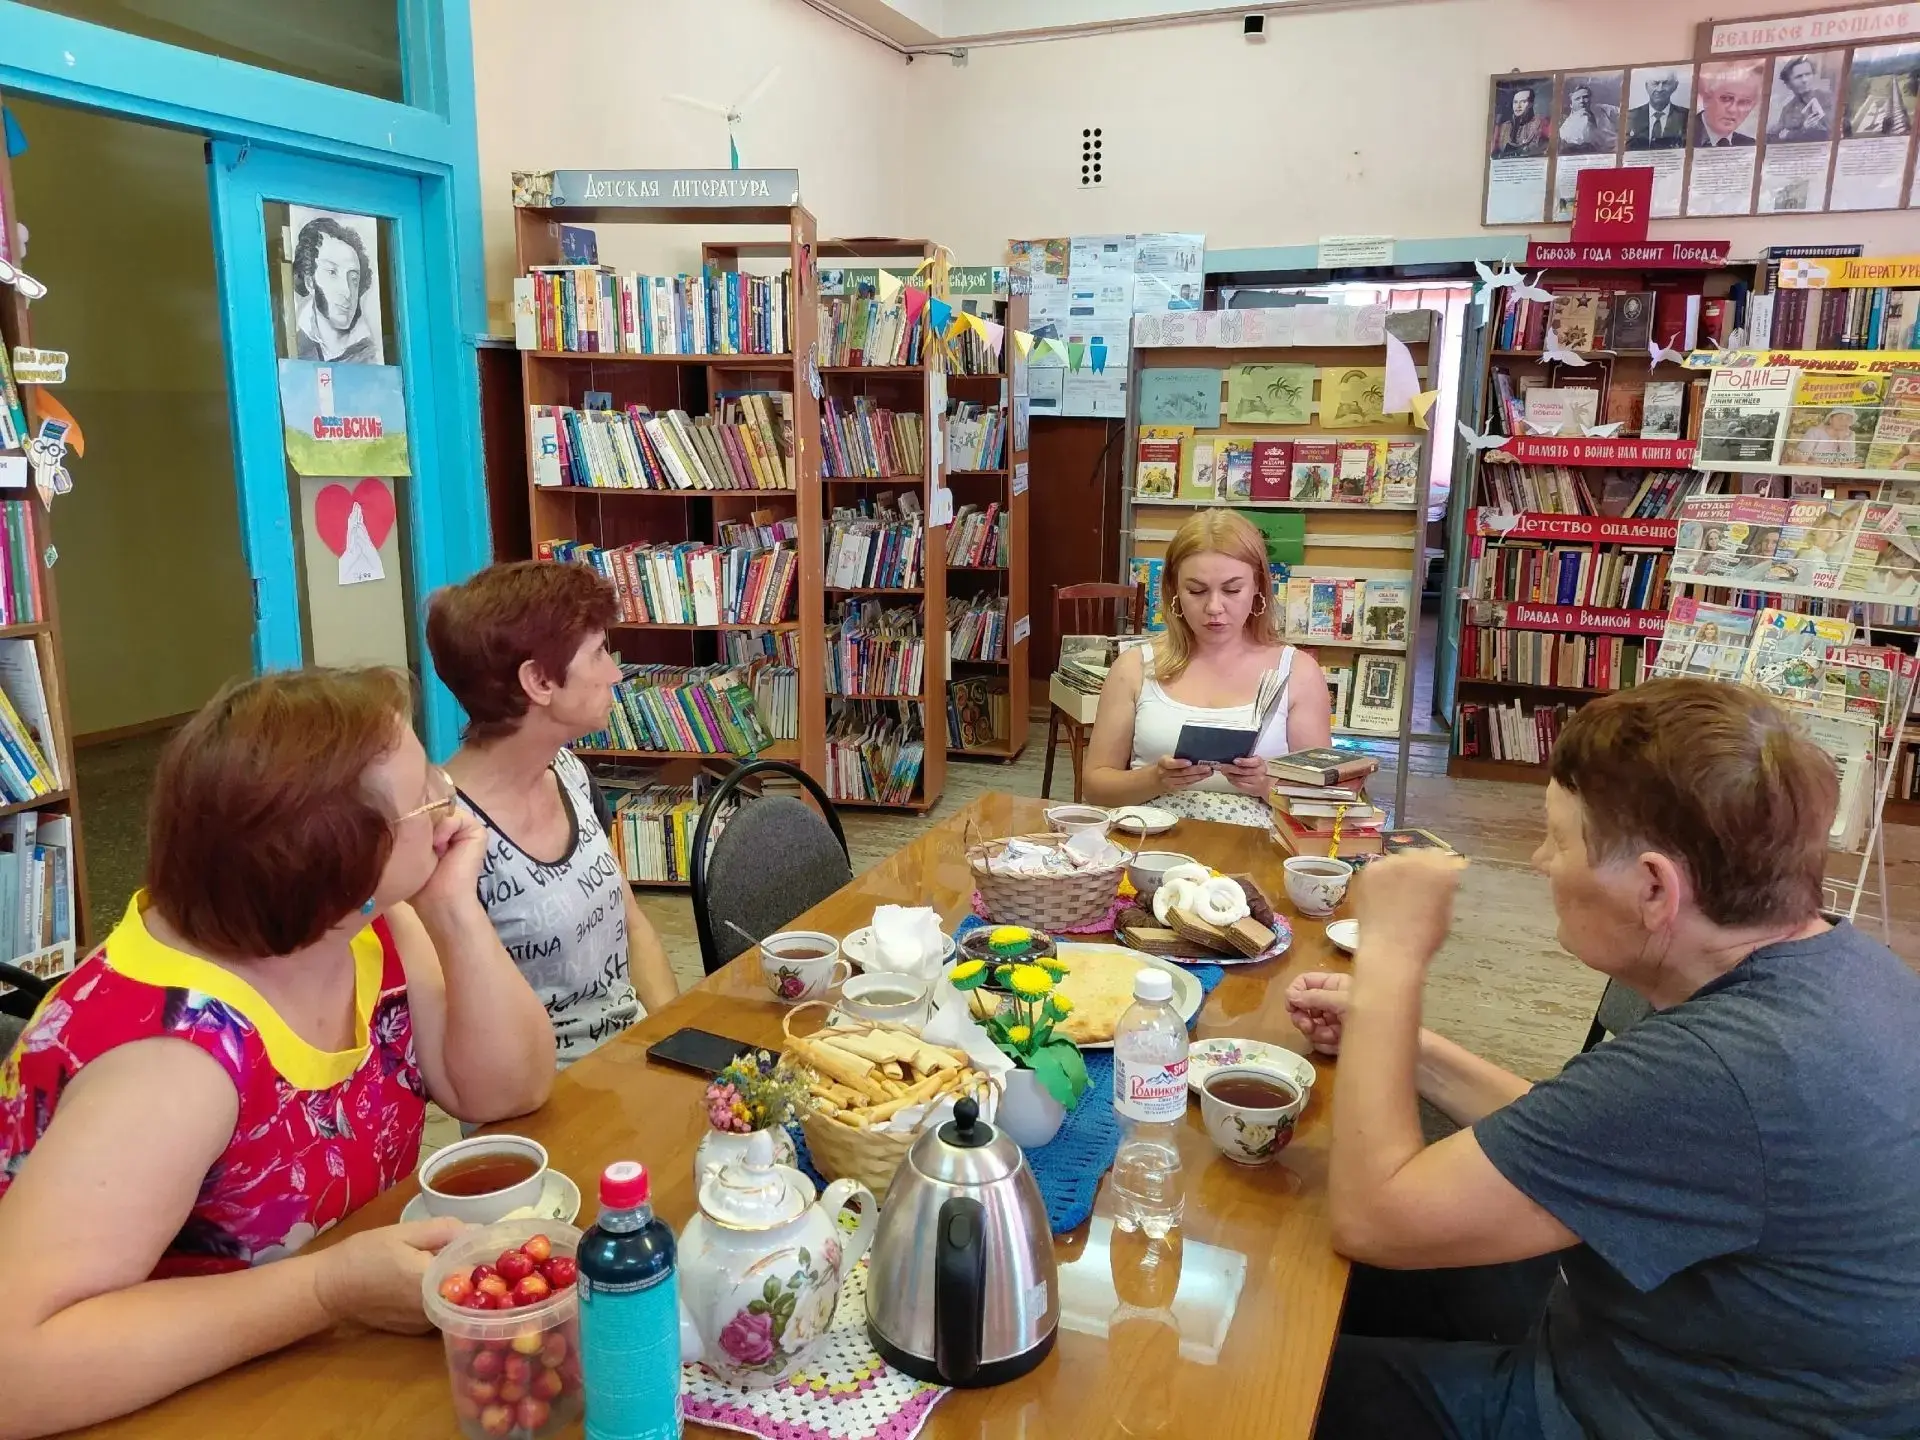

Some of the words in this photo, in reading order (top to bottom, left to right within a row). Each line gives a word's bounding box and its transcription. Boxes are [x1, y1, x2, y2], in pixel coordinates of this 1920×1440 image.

[583, 173, 660, 199] Детская
[672, 179, 771, 197] литература
[1597, 189, 1634, 207] 1941
[1594, 206, 1634, 224] 1945
[1535, 245, 1577, 261] Сквозь
[1582, 247, 1612, 262] года
[1621, 246, 1663, 261] звенит
[1672, 243, 1719, 262] Победа
[1517, 442, 1525, 456] И
[1711, 510, 1731, 518] УЙД
[1516, 606, 1560, 625] Правда
[1565, 614, 1573, 624] о
[1579, 609, 1631, 628] Великой
